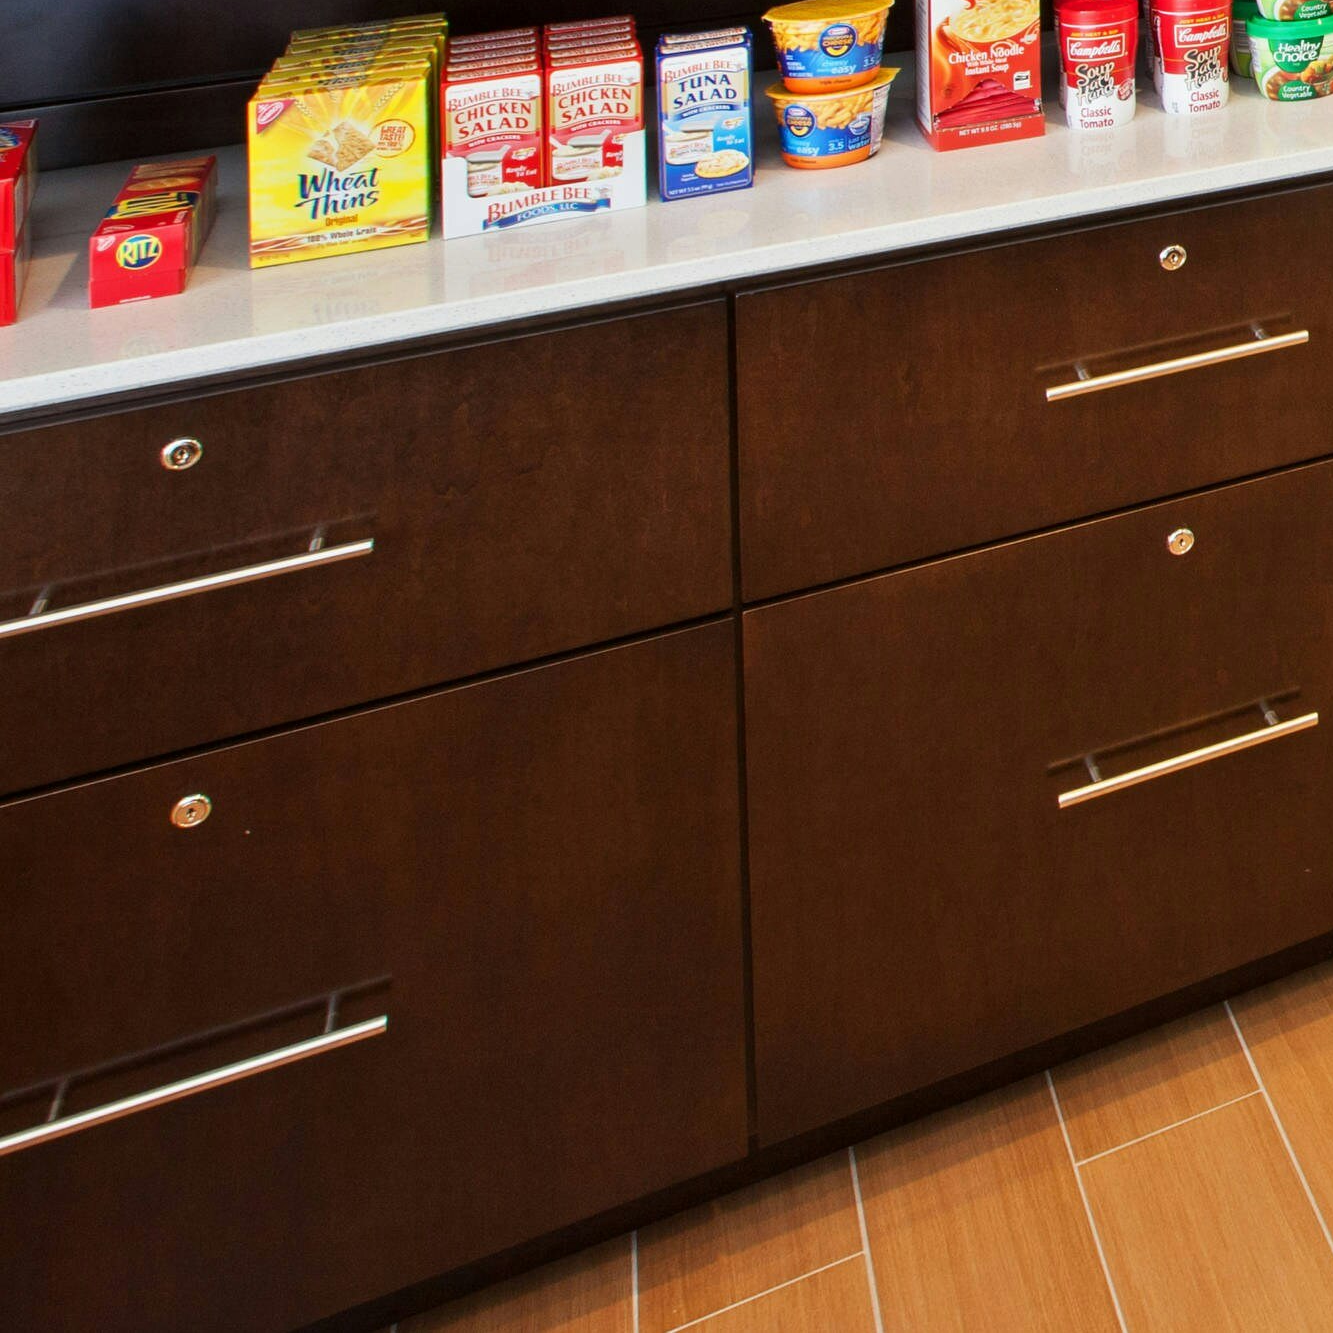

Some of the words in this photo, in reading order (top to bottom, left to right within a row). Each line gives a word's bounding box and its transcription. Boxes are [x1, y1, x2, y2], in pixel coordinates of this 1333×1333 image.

[1300, 2, 1328, 13] Country
[1178, 23, 1227, 43] Campbell's
[948, 51, 988, 65] Chicken
[990, 44, 1025, 60] Noodle
[1069, 40, 1121, 59] Campbell's
[1273, 50, 1319, 63] Choice
[1277, 40, 1321, 53] Healthy
[1183, 45, 1222, 72] Soup
[664, 61, 710, 85] BUMBLE
[713, 59, 732, 70] BEE
[831, 65, 857, 76] easy
[964, 66, 990, 76] Instant
[991, 63, 1009, 75] Soup
[1075, 61, 1116, 87] Soup
[552, 76, 600, 98] BUMBLE
[603, 73, 623, 84] BEE
[678, 73, 732, 93] TUNA
[1283, 84, 1311, 93] Country
[447, 89, 501, 113] BUMBLE
[502, 86, 522, 98] BEE
[558, 86, 633, 110] CHICKEN
[673, 87, 738, 110] SALAD
[1190, 89, 1220, 102] Classic
[1281, 90, 1313, 100] Vegetable
[455, 102, 533, 125] CHICKEN
[560, 101, 629, 124] SALAD
[1080, 107, 1113, 118] Classic
[1188, 100, 1222, 113] Tomato
[458, 116, 529, 141] SALAD
[1079, 118, 1115, 129] Tomato
[796, 145, 820, 156] easy
[828, 140, 844, 152] 3.5
[298, 166, 379, 200] Wheat
[293, 189, 380, 220] Thins
[486, 190, 561, 225] BUMBLE
[563, 186, 594, 203] BEE
[558, 201, 579, 212] LLC
[325, 213, 359, 227] Original
[117, 238, 159, 267] RITZ
